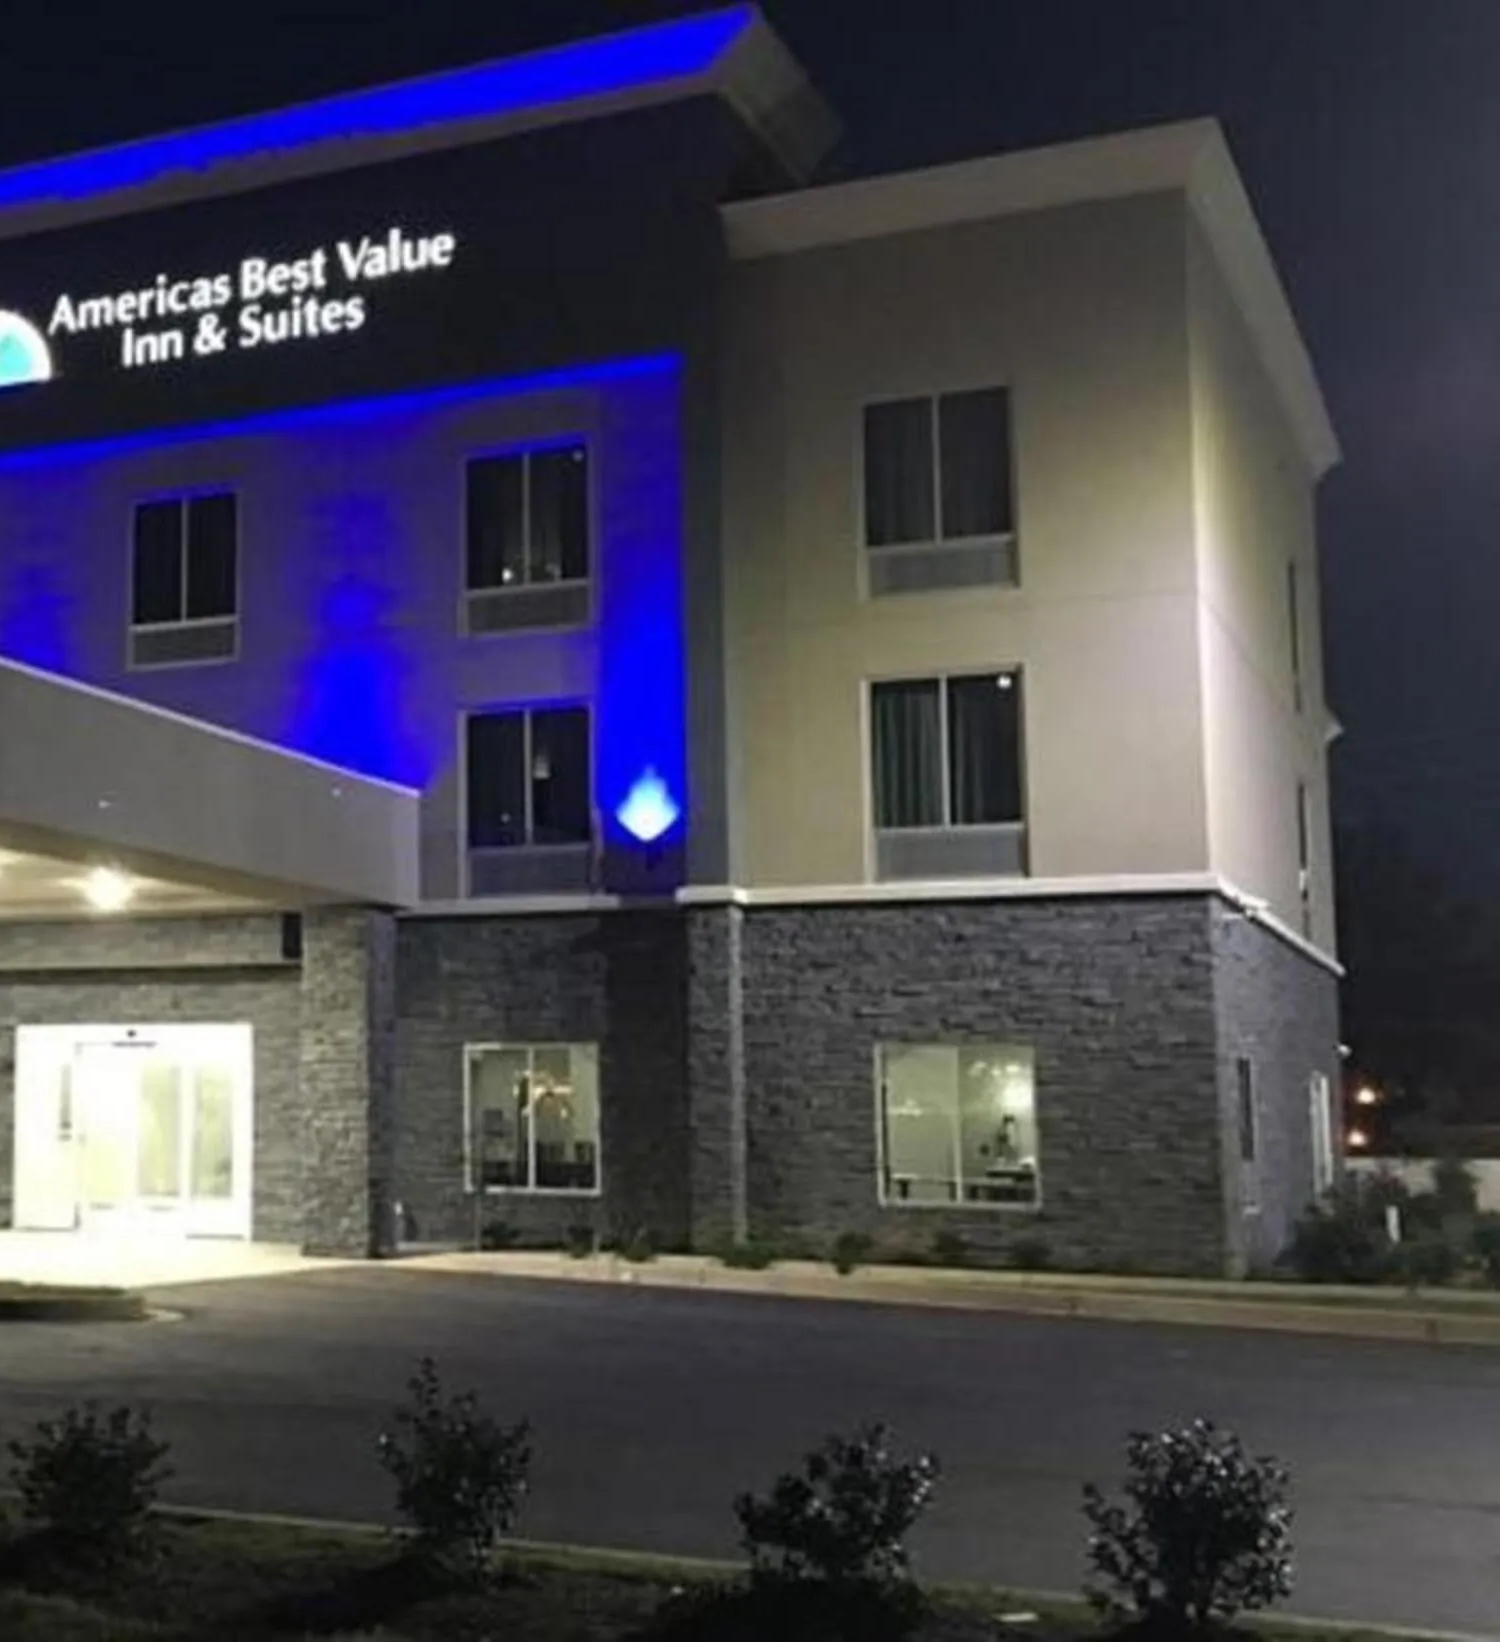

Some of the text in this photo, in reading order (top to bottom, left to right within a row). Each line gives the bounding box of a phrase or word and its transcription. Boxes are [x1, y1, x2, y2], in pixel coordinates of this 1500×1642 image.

[47, 227, 456, 336] Americas Best Value
[121, 295, 366, 368] Inn & Suites
